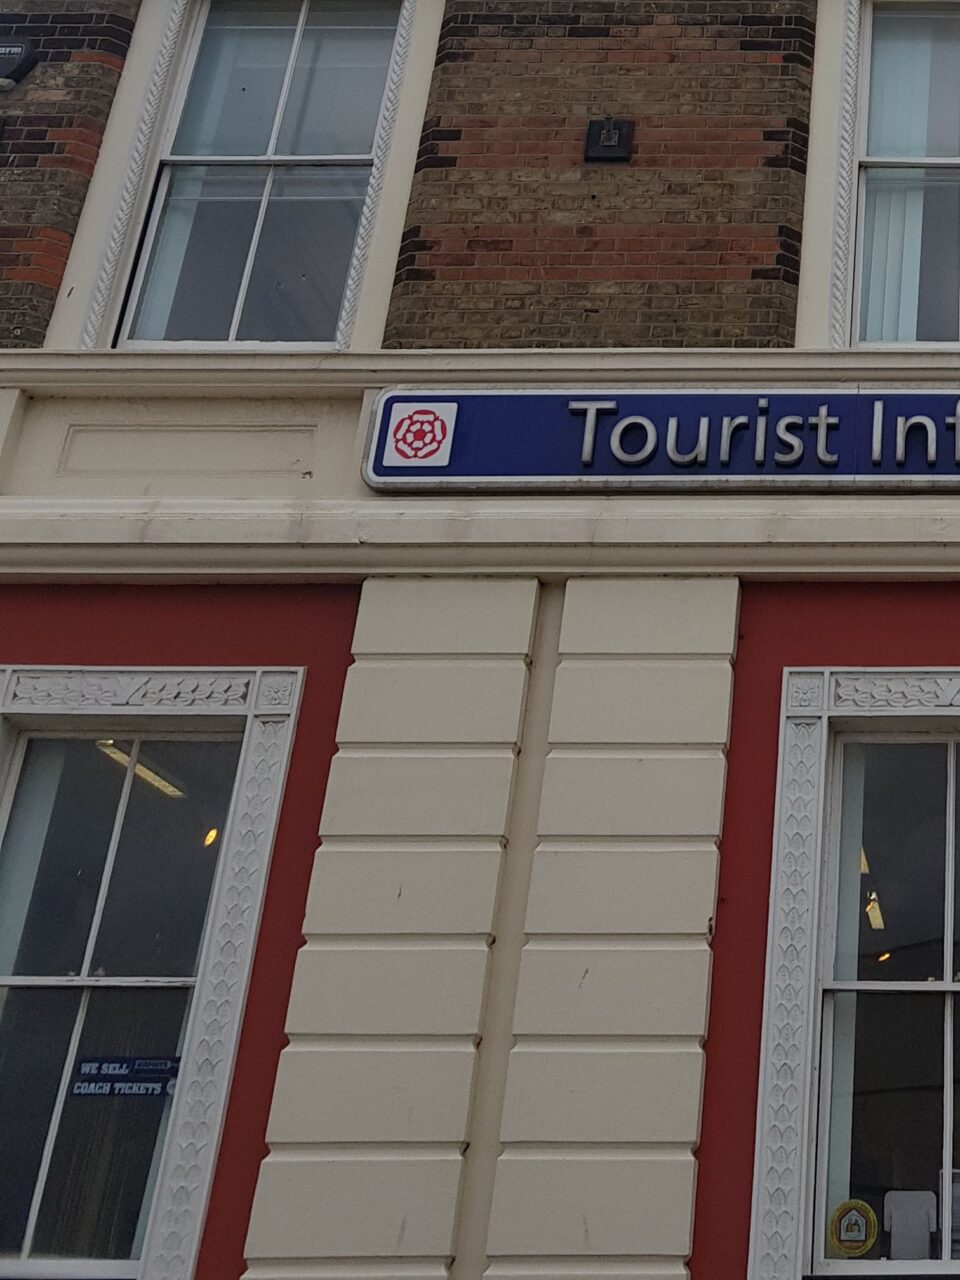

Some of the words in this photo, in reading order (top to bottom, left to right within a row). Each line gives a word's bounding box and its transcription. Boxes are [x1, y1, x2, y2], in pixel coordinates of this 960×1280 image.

[568, 397, 839, 466] Tourist
[80, 1063, 99, 1074] WE
[101, 1063, 129, 1075] SELL
[73, 1082, 111, 1095] COACH
[113, 1082, 162, 1095] TICKETS
